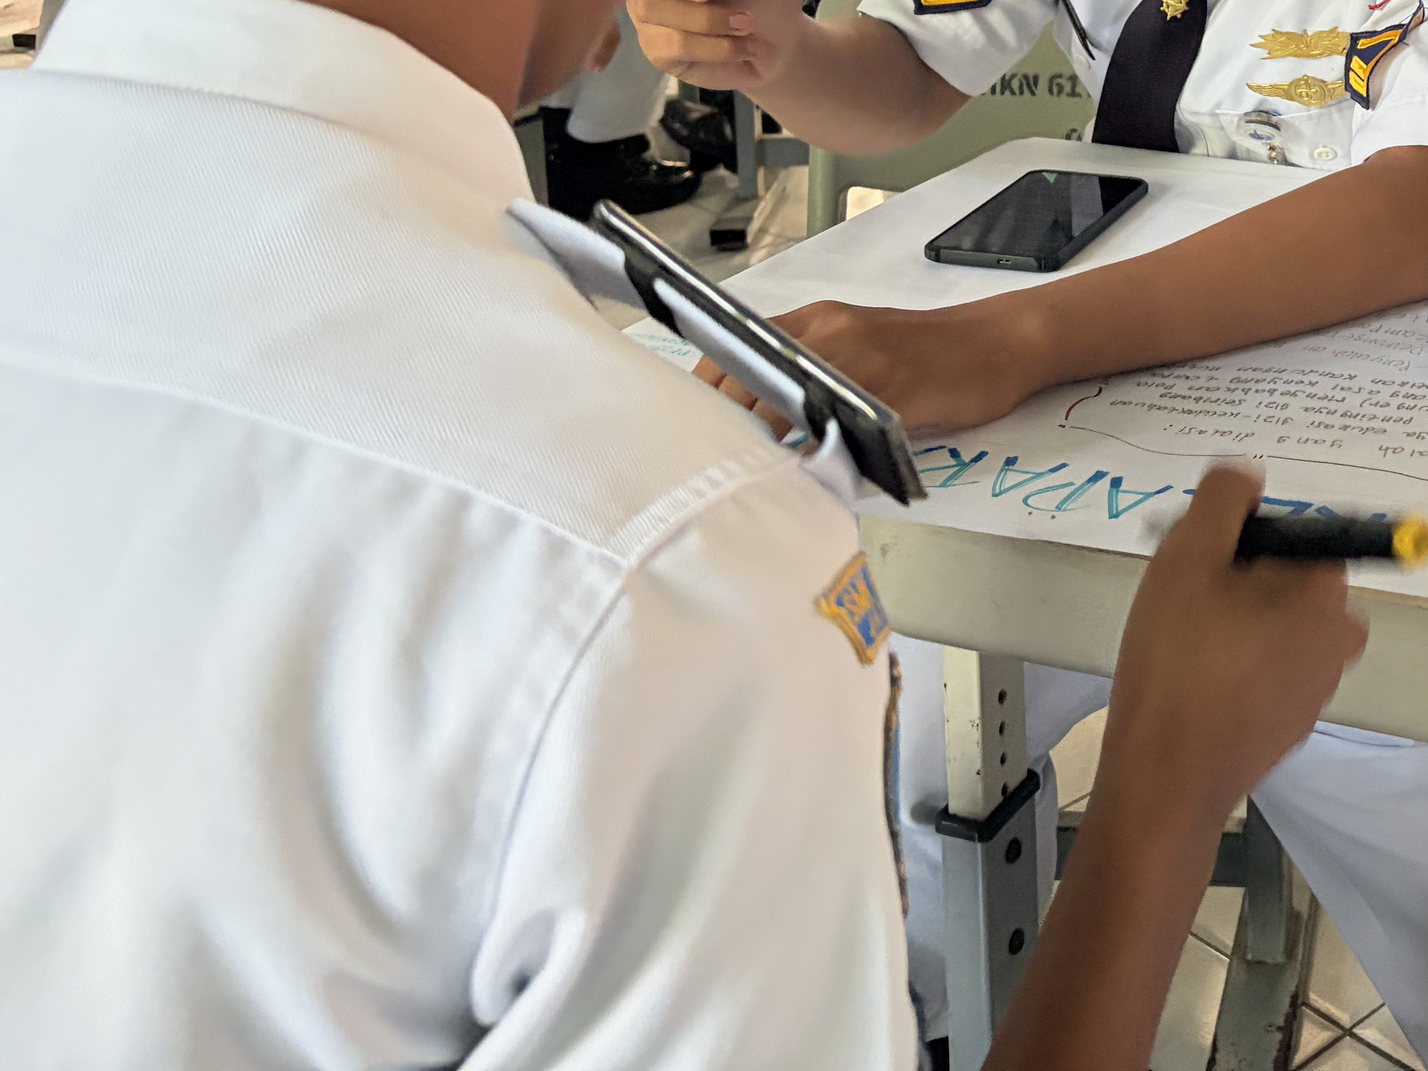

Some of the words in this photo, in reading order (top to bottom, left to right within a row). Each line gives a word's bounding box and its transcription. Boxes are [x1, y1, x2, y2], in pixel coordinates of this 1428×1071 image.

[989, 72, 1040, 97] KN
[1300, 407, 1413, 424] pentingnya
[1306, 421, 1387, 435] edukasi
[1276, 436, 1343, 449] yang
